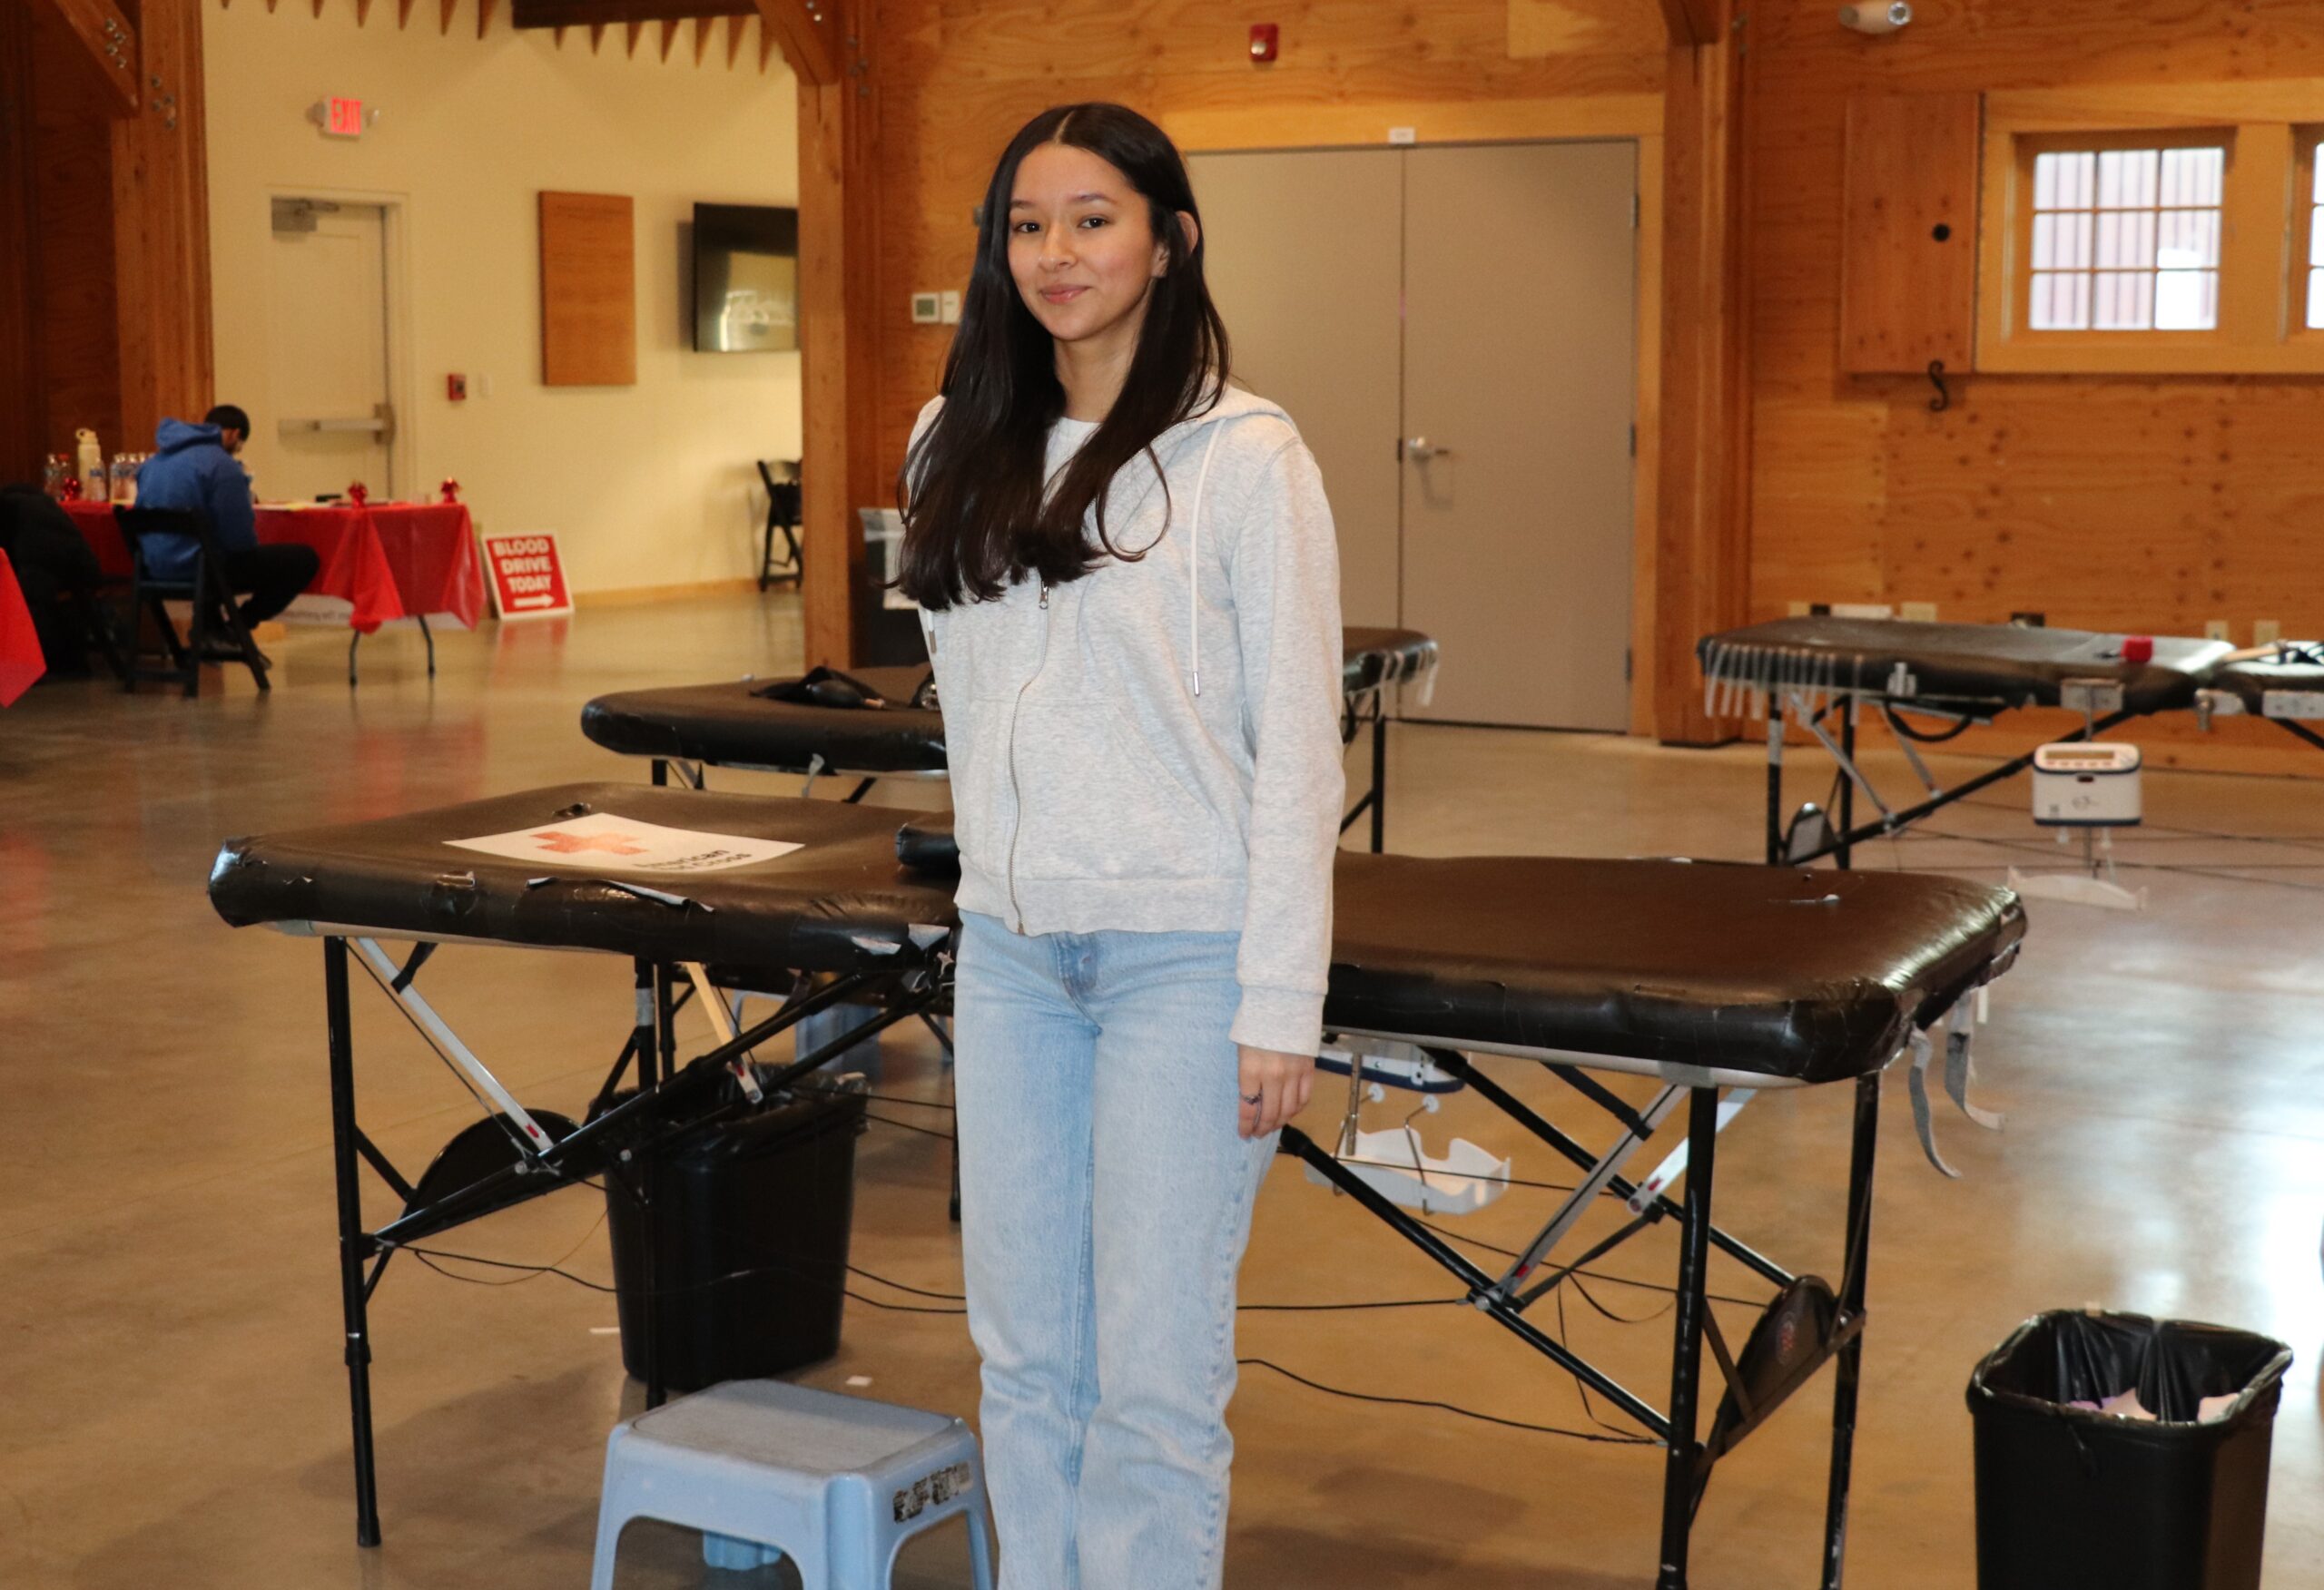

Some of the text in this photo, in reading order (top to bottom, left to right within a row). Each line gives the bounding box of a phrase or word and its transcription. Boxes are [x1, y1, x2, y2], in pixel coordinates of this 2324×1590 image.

[331, 97, 362, 134] EXIT
[492, 537, 550, 556] BLOOD
[500, 555, 553, 575] DRIVE
[507, 574, 552, 594] TODAY
